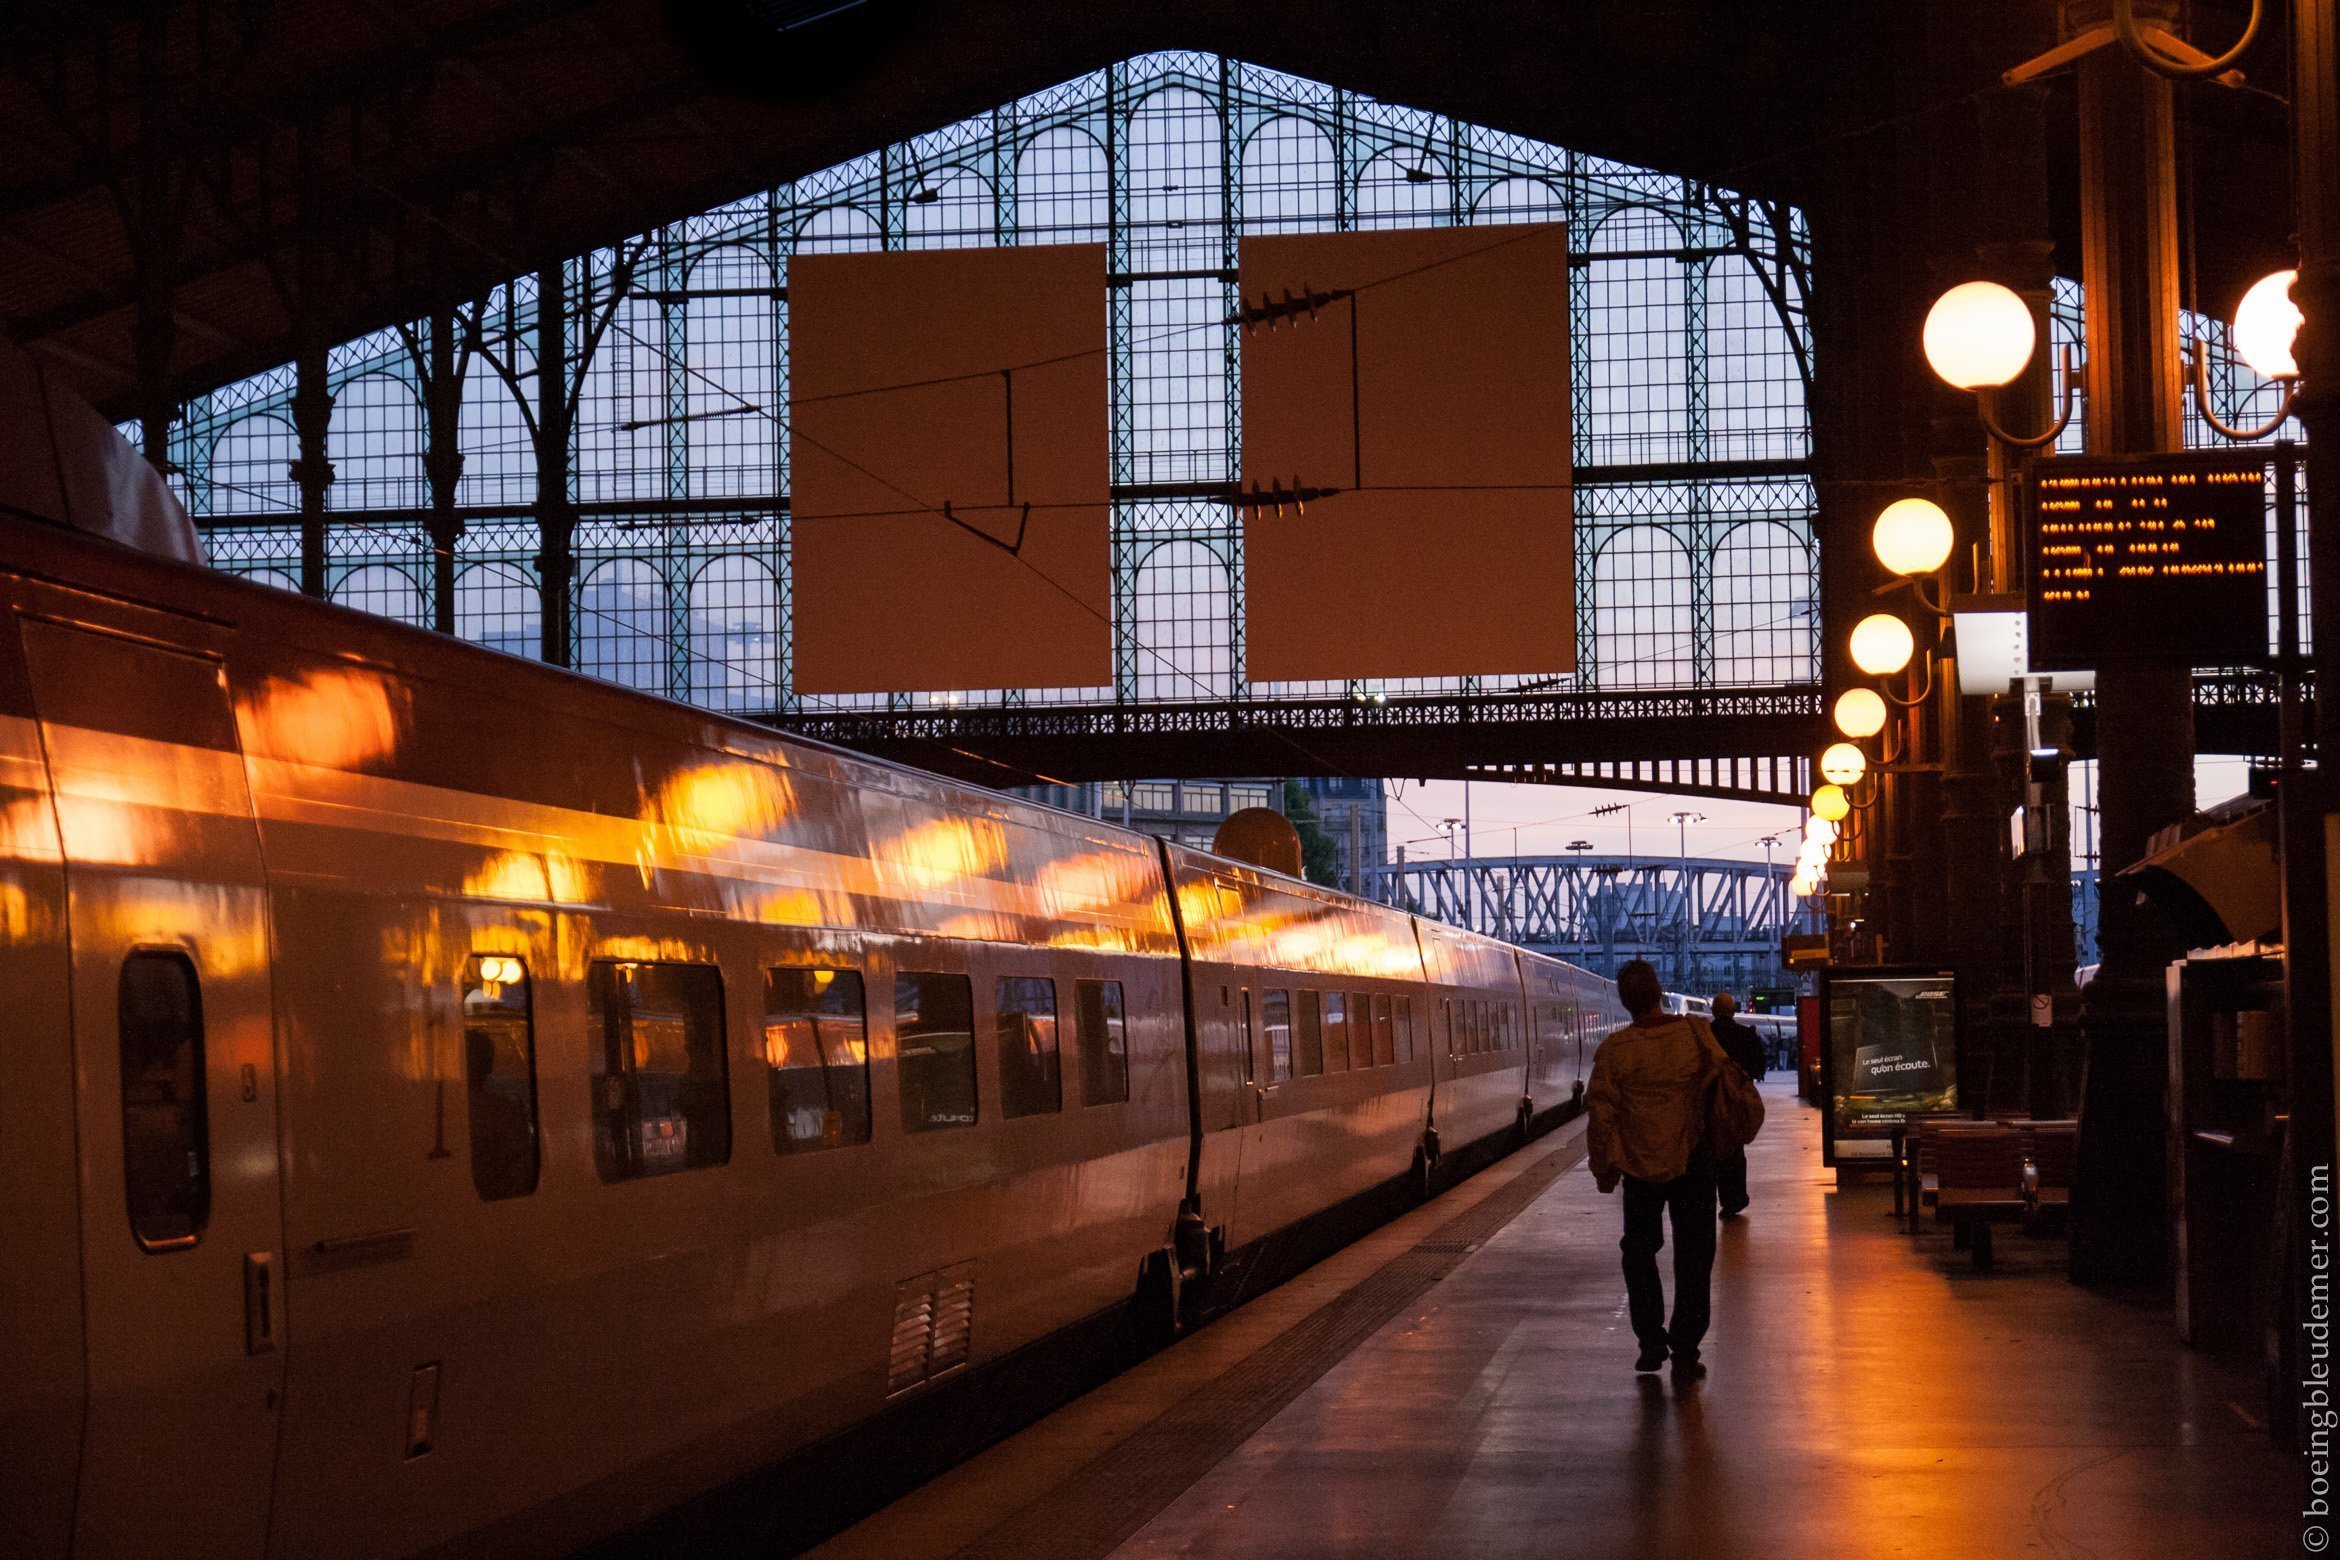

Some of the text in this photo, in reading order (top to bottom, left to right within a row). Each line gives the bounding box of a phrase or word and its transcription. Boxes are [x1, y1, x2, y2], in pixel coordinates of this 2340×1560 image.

[1862, 1054, 1903, 1066] Le seul écran
[1894, 1059, 1931, 1072] écoute.
